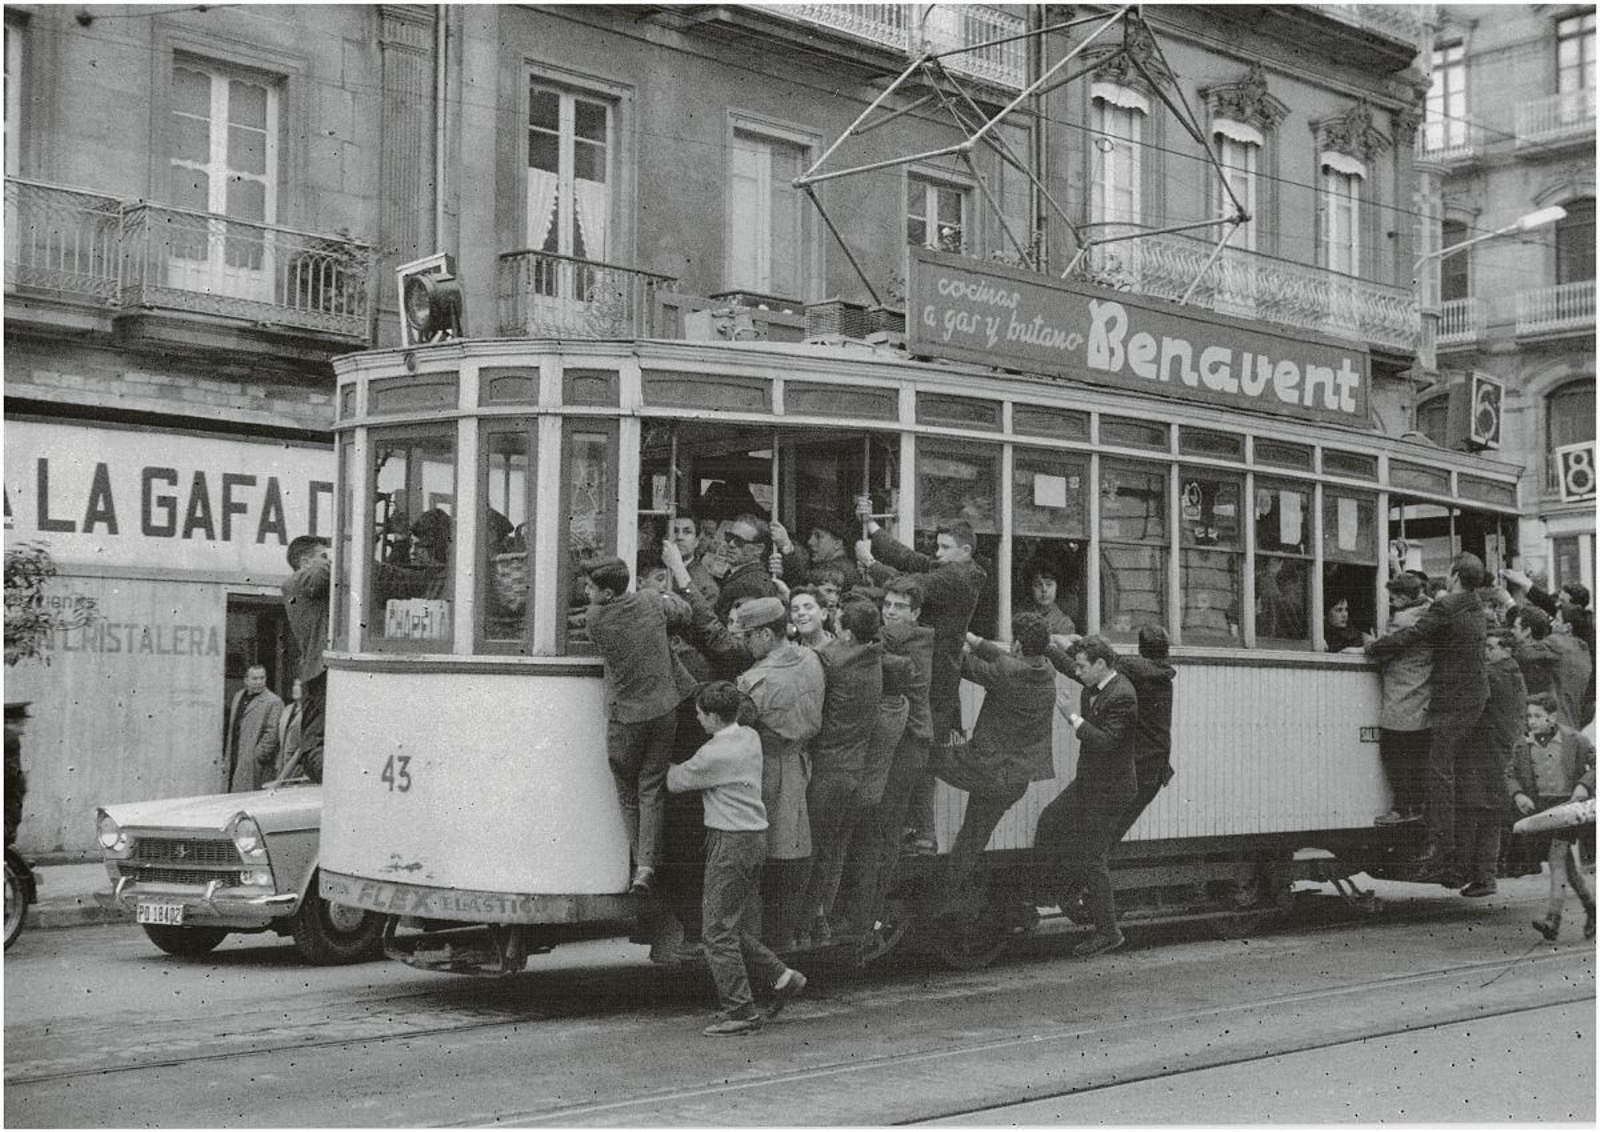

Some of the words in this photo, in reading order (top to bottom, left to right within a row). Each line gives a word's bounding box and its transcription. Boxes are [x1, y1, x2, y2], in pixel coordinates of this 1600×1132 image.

[938, 278, 1021, 308] cocinas
[924, 305, 936, 327] a
[943, 309, 981, 341] gas
[986, 316, 1001, 348] y
[1007, 309, 1084, 350] butano
[1087, 299, 1360, 413] Benavent
[1475, 384, 1497, 440] 6
[1567, 451, 1594, 493] 8
[37, 457, 119, 535] LA
[141, 466, 288, 546] GAFA
[381, 754, 411, 792] 43
[357, 882, 434, 914] FLEX
